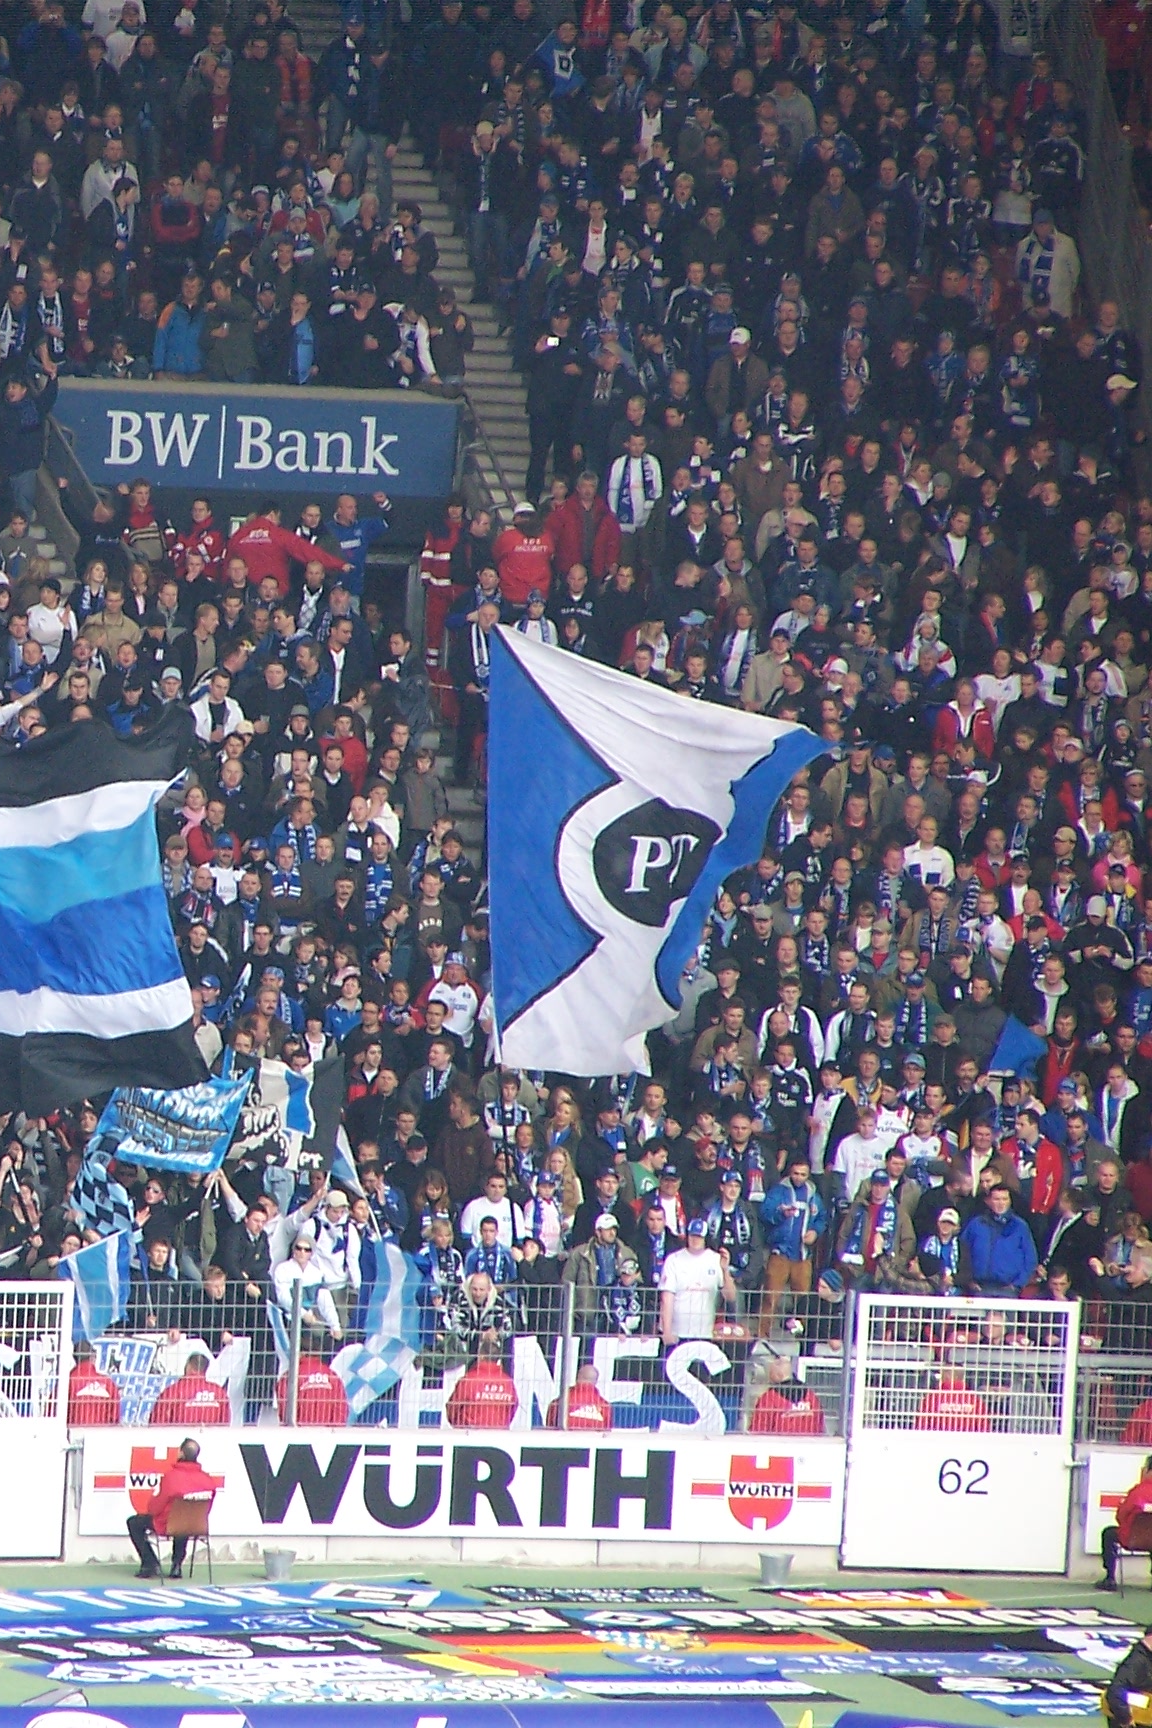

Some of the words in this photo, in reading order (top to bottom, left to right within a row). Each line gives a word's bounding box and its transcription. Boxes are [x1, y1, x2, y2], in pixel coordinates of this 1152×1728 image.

[104, 410, 210, 468] BW
[234, 415, 399, 476] Bank
[624, 834, 700, 893] PT
[238, 1443, 677, 1530] WÜRTH
[938, 1458, 990, 1495] 62
[34, 1586, 320, 1610] TOUR
[671, 1609, 1140, 1627] PATRICK
